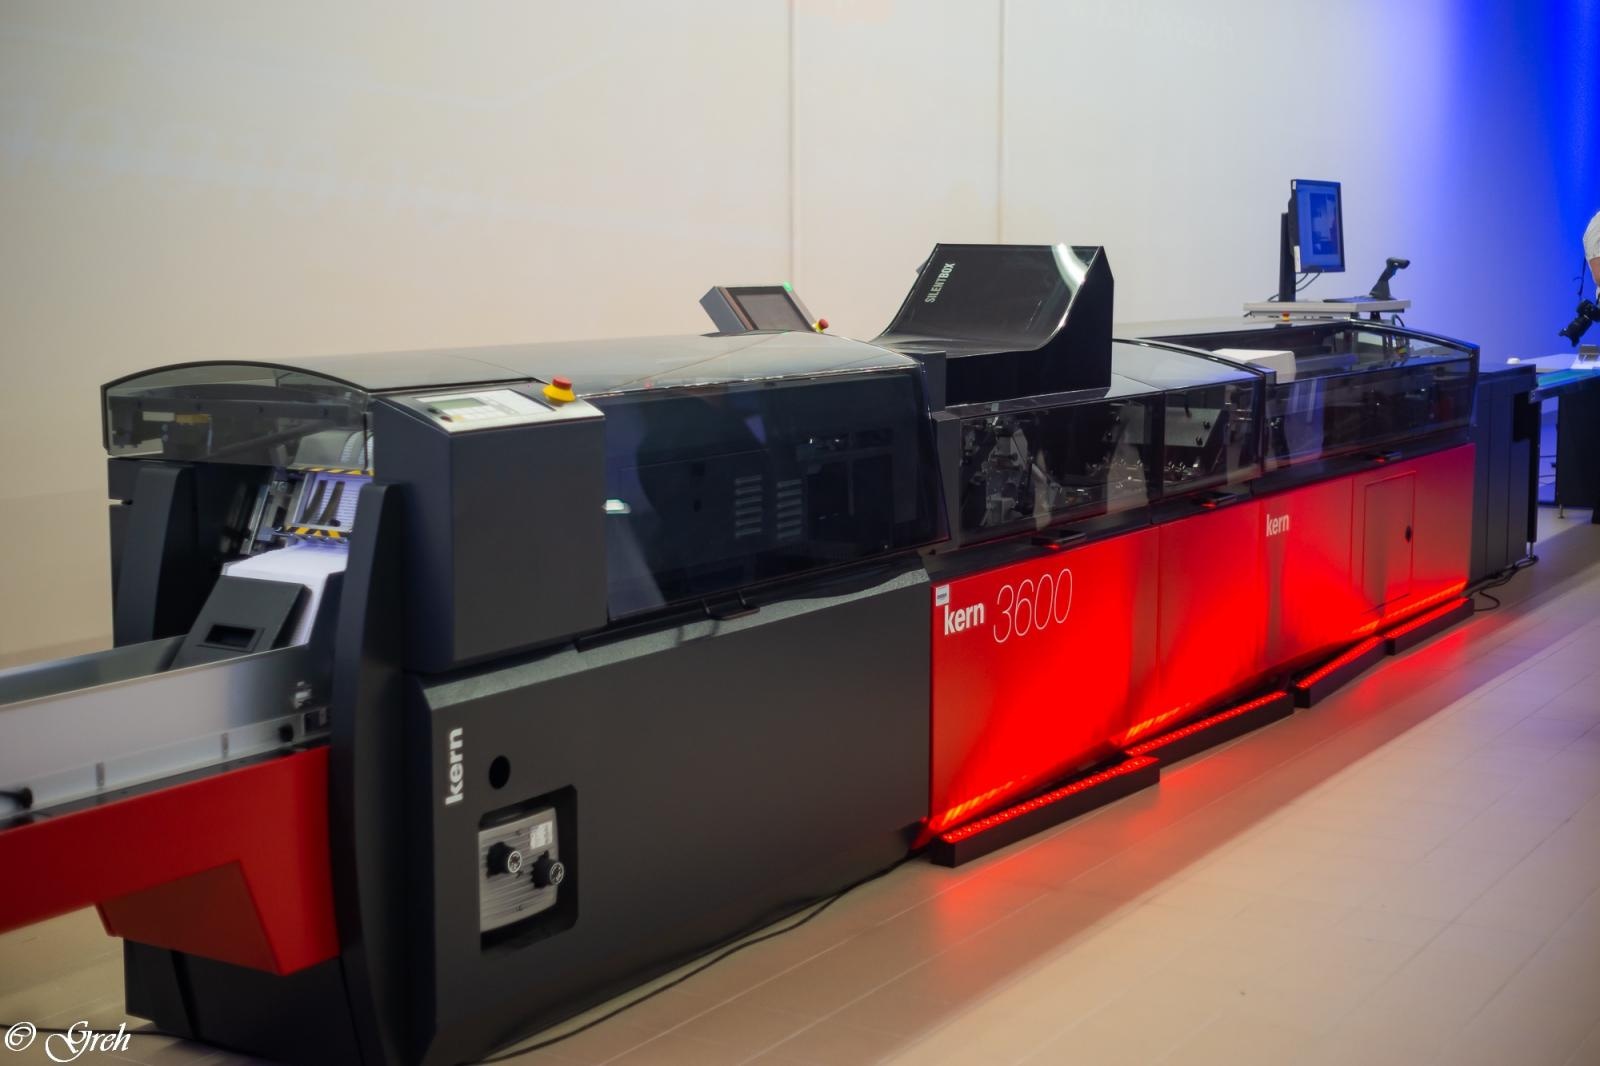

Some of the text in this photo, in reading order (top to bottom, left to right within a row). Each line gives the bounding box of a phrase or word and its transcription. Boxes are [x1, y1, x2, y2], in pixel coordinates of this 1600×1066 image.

[924, 262, 956, 303] SILENTBOX
[1266, 513, 1290, 537] kern
[944, 568, 1073, 643] kern 3600
[445, 727, 464, 806] kern
